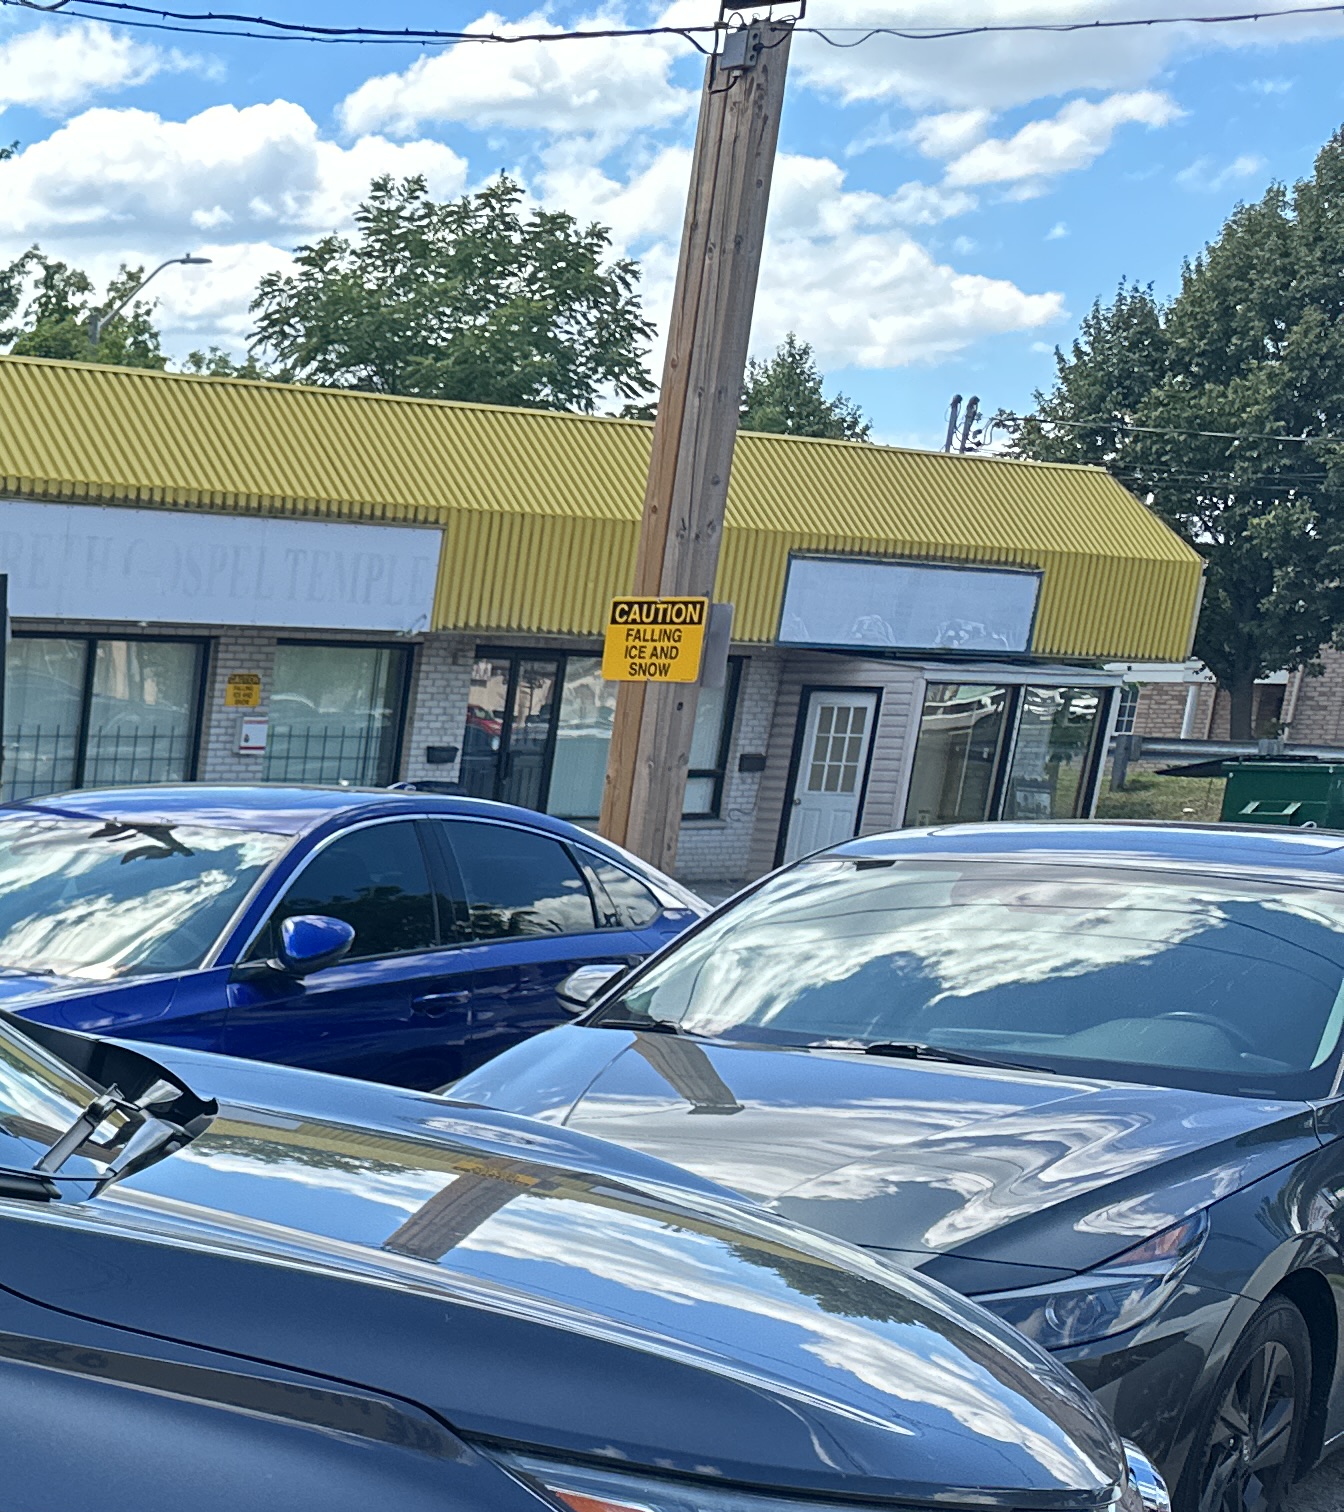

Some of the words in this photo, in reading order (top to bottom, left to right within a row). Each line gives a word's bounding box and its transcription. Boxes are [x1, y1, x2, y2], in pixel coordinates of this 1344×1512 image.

[615, 603, 701, 623] CAUTION
[625, 628, 683, 643] FALLING
[624, 645, 647, 660] ICE
[649, 645, 679, 660] AND
[628, 662, 671, 677] SNOW
